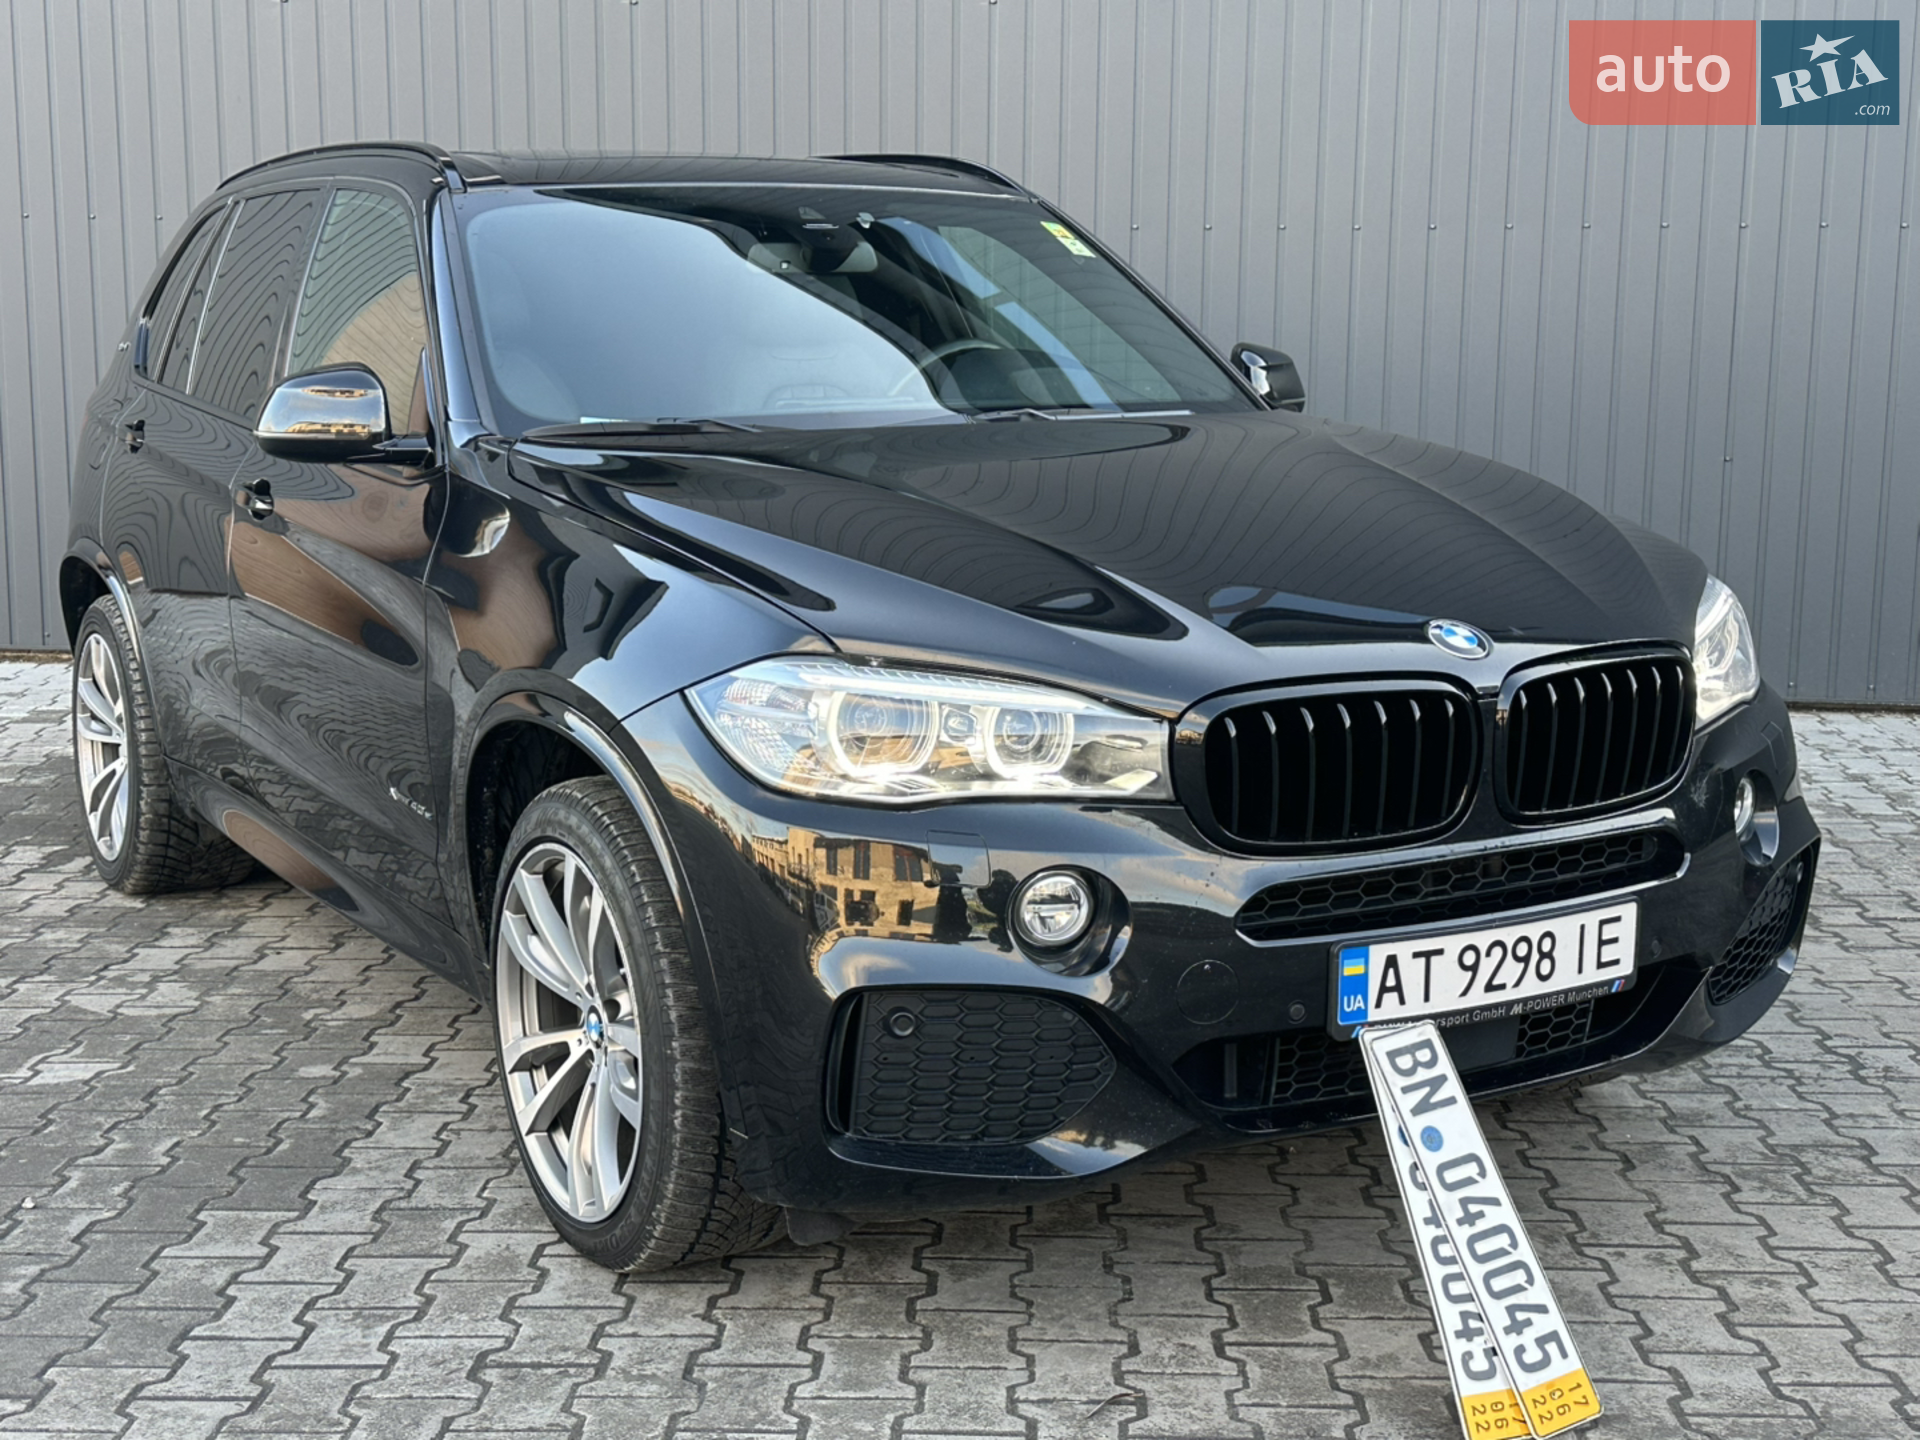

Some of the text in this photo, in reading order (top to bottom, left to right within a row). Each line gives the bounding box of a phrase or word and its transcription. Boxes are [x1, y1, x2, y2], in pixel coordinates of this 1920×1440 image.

[1373, 914, 1623, 1010] AT 9298 IE
[1343, 994, 1366, 1012] UA
[1472, 1005, 1506, 1022] GmbH
[1385, 1038, 1458, 1118] BN
[1435, 1152, 1570, 1374] 040045
